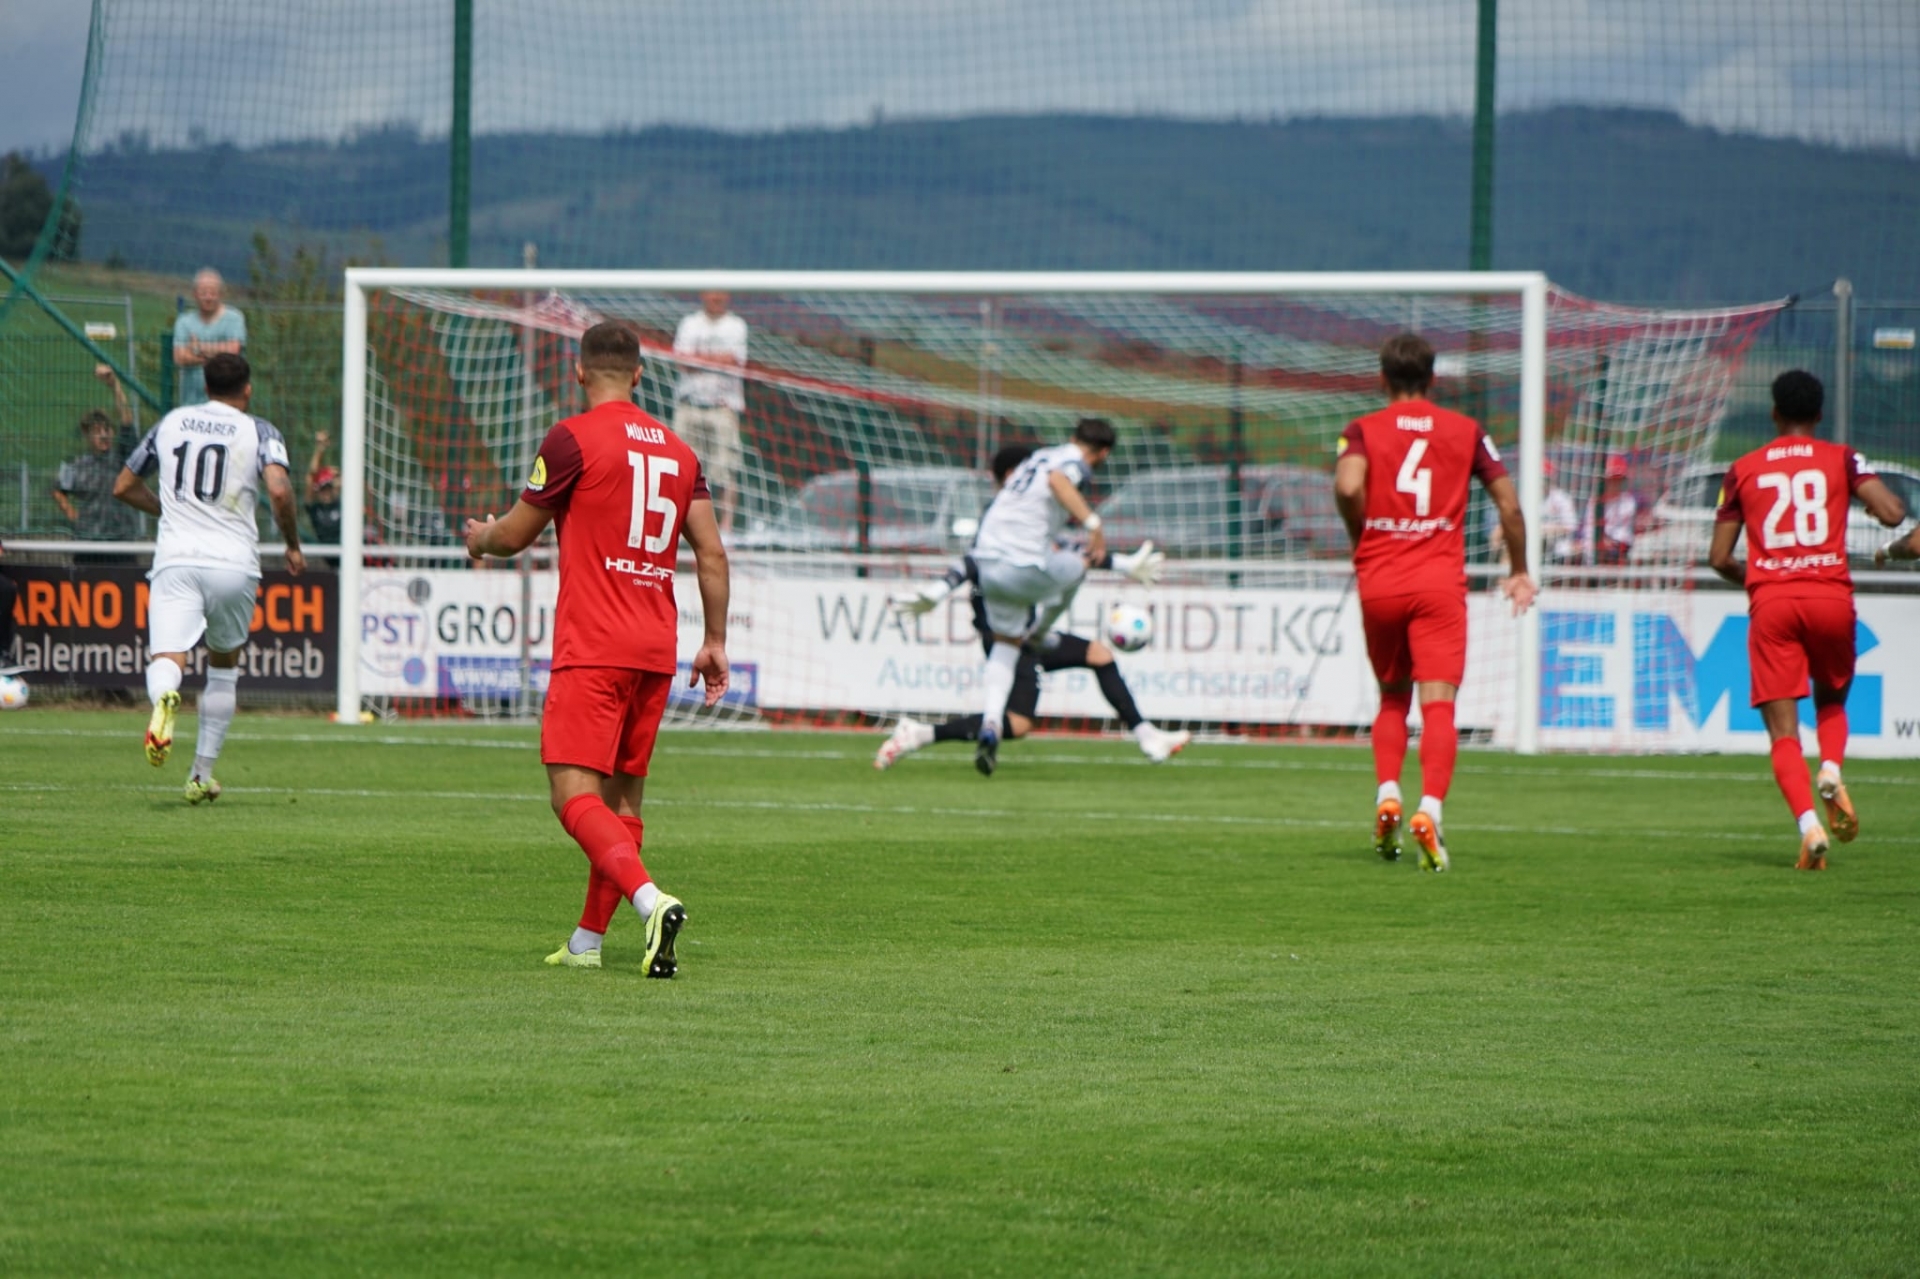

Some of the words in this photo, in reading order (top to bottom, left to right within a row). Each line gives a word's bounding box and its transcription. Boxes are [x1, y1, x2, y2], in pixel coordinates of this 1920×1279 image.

[625, 423, 666, 445] MÜLLER
[173, 441, 228, 505] 10
[627, 450, 679, 554] 15
[1396, 438, 1432, 516] 4
[1757, 469, 1829, 549] 28
[361, 613, 421, 645] PST
[438, 604, 557, 644] GROU
